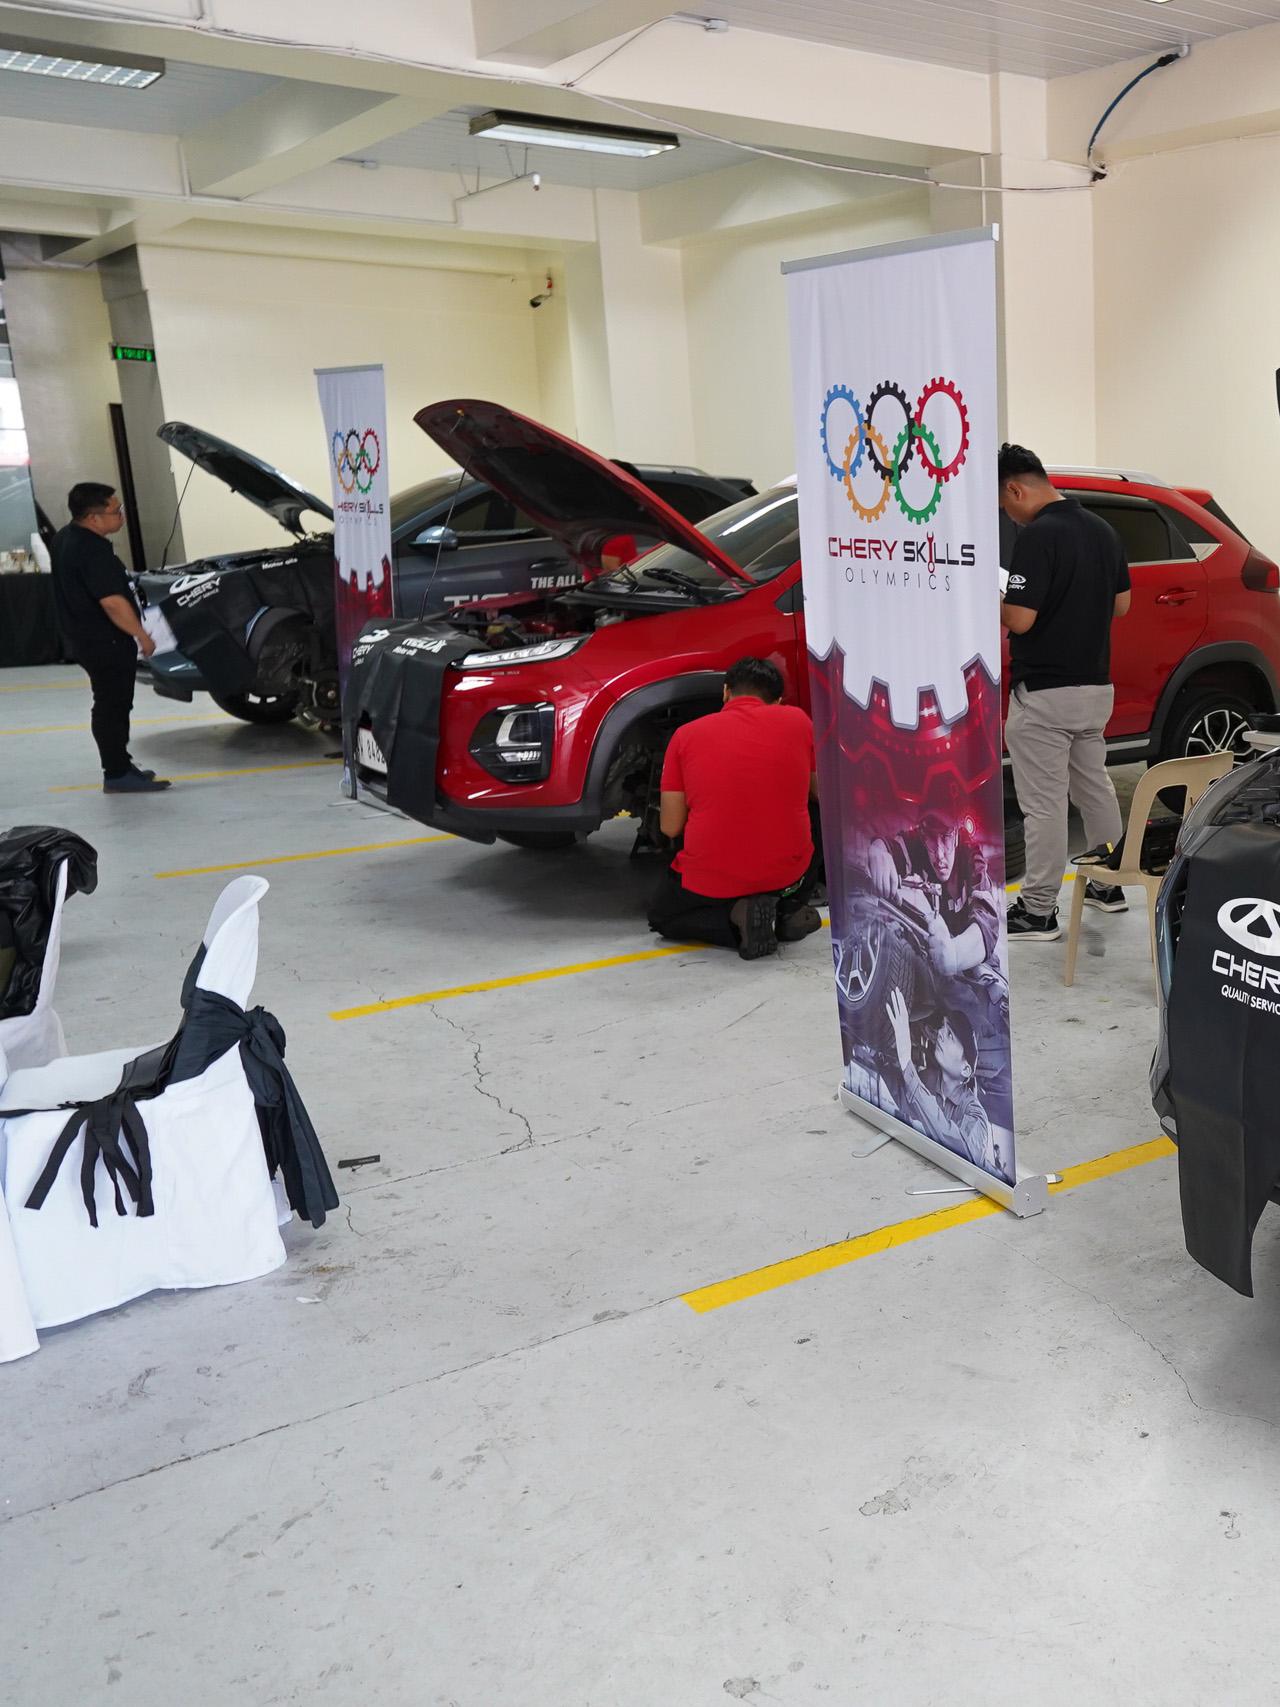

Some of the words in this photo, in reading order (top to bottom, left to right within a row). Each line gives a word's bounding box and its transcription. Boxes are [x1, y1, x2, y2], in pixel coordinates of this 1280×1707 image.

[828, 537, 898, 560] CHERY
[904, 534, 976, 572] SKILLS
[176, 576, 221, 607] CHERY
[530, 576, 554, 590] THE
[845, 566, 952, 592] OLYMPICS
[1221, 984, 1250, 1004] QUALITY
